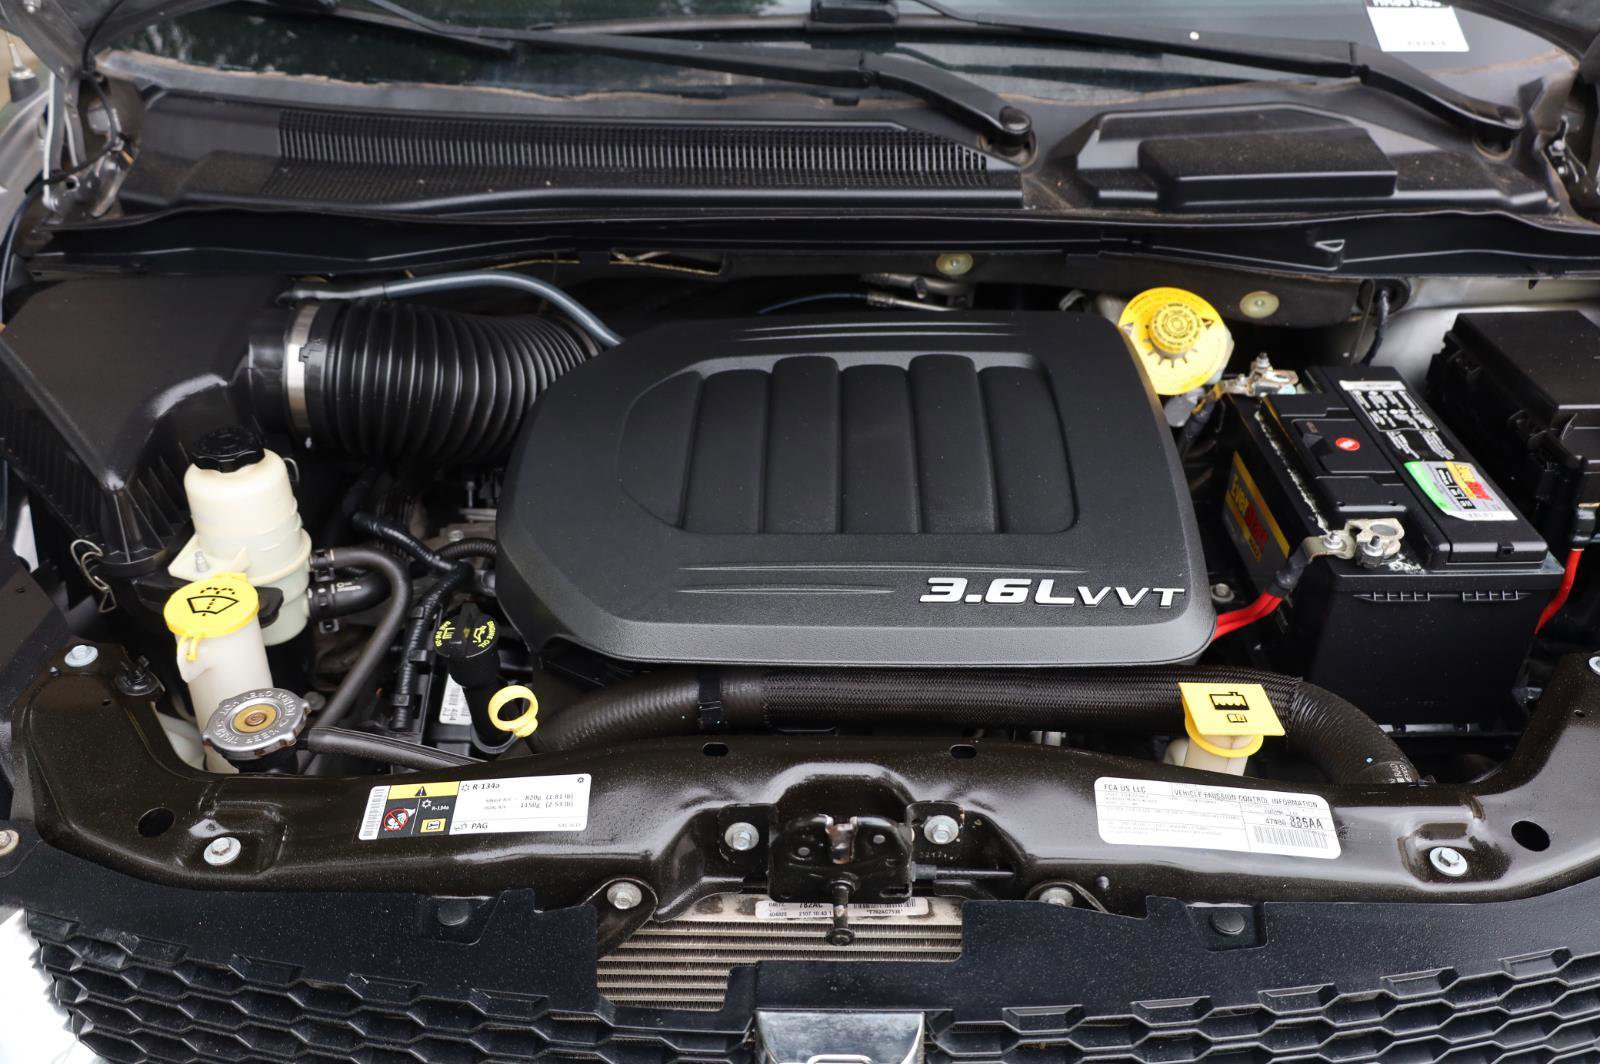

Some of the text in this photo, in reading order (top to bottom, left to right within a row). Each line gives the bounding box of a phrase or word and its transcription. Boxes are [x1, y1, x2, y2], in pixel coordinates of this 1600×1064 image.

[919, 577, 1186, 608] 3.6L VVT
[477, 620, 496, 649] ENGINE OIL
[1104, 783, 1118, 791] FCA
[1119, 784, 1130, 792] US
[1174, 788, 1202, 798] VEHICLE
[1238, 794, 1269, 804] CONTROL
[1271, 798, 1319, 808] INFORMATION
[471, 822, 489, 830] PAG
